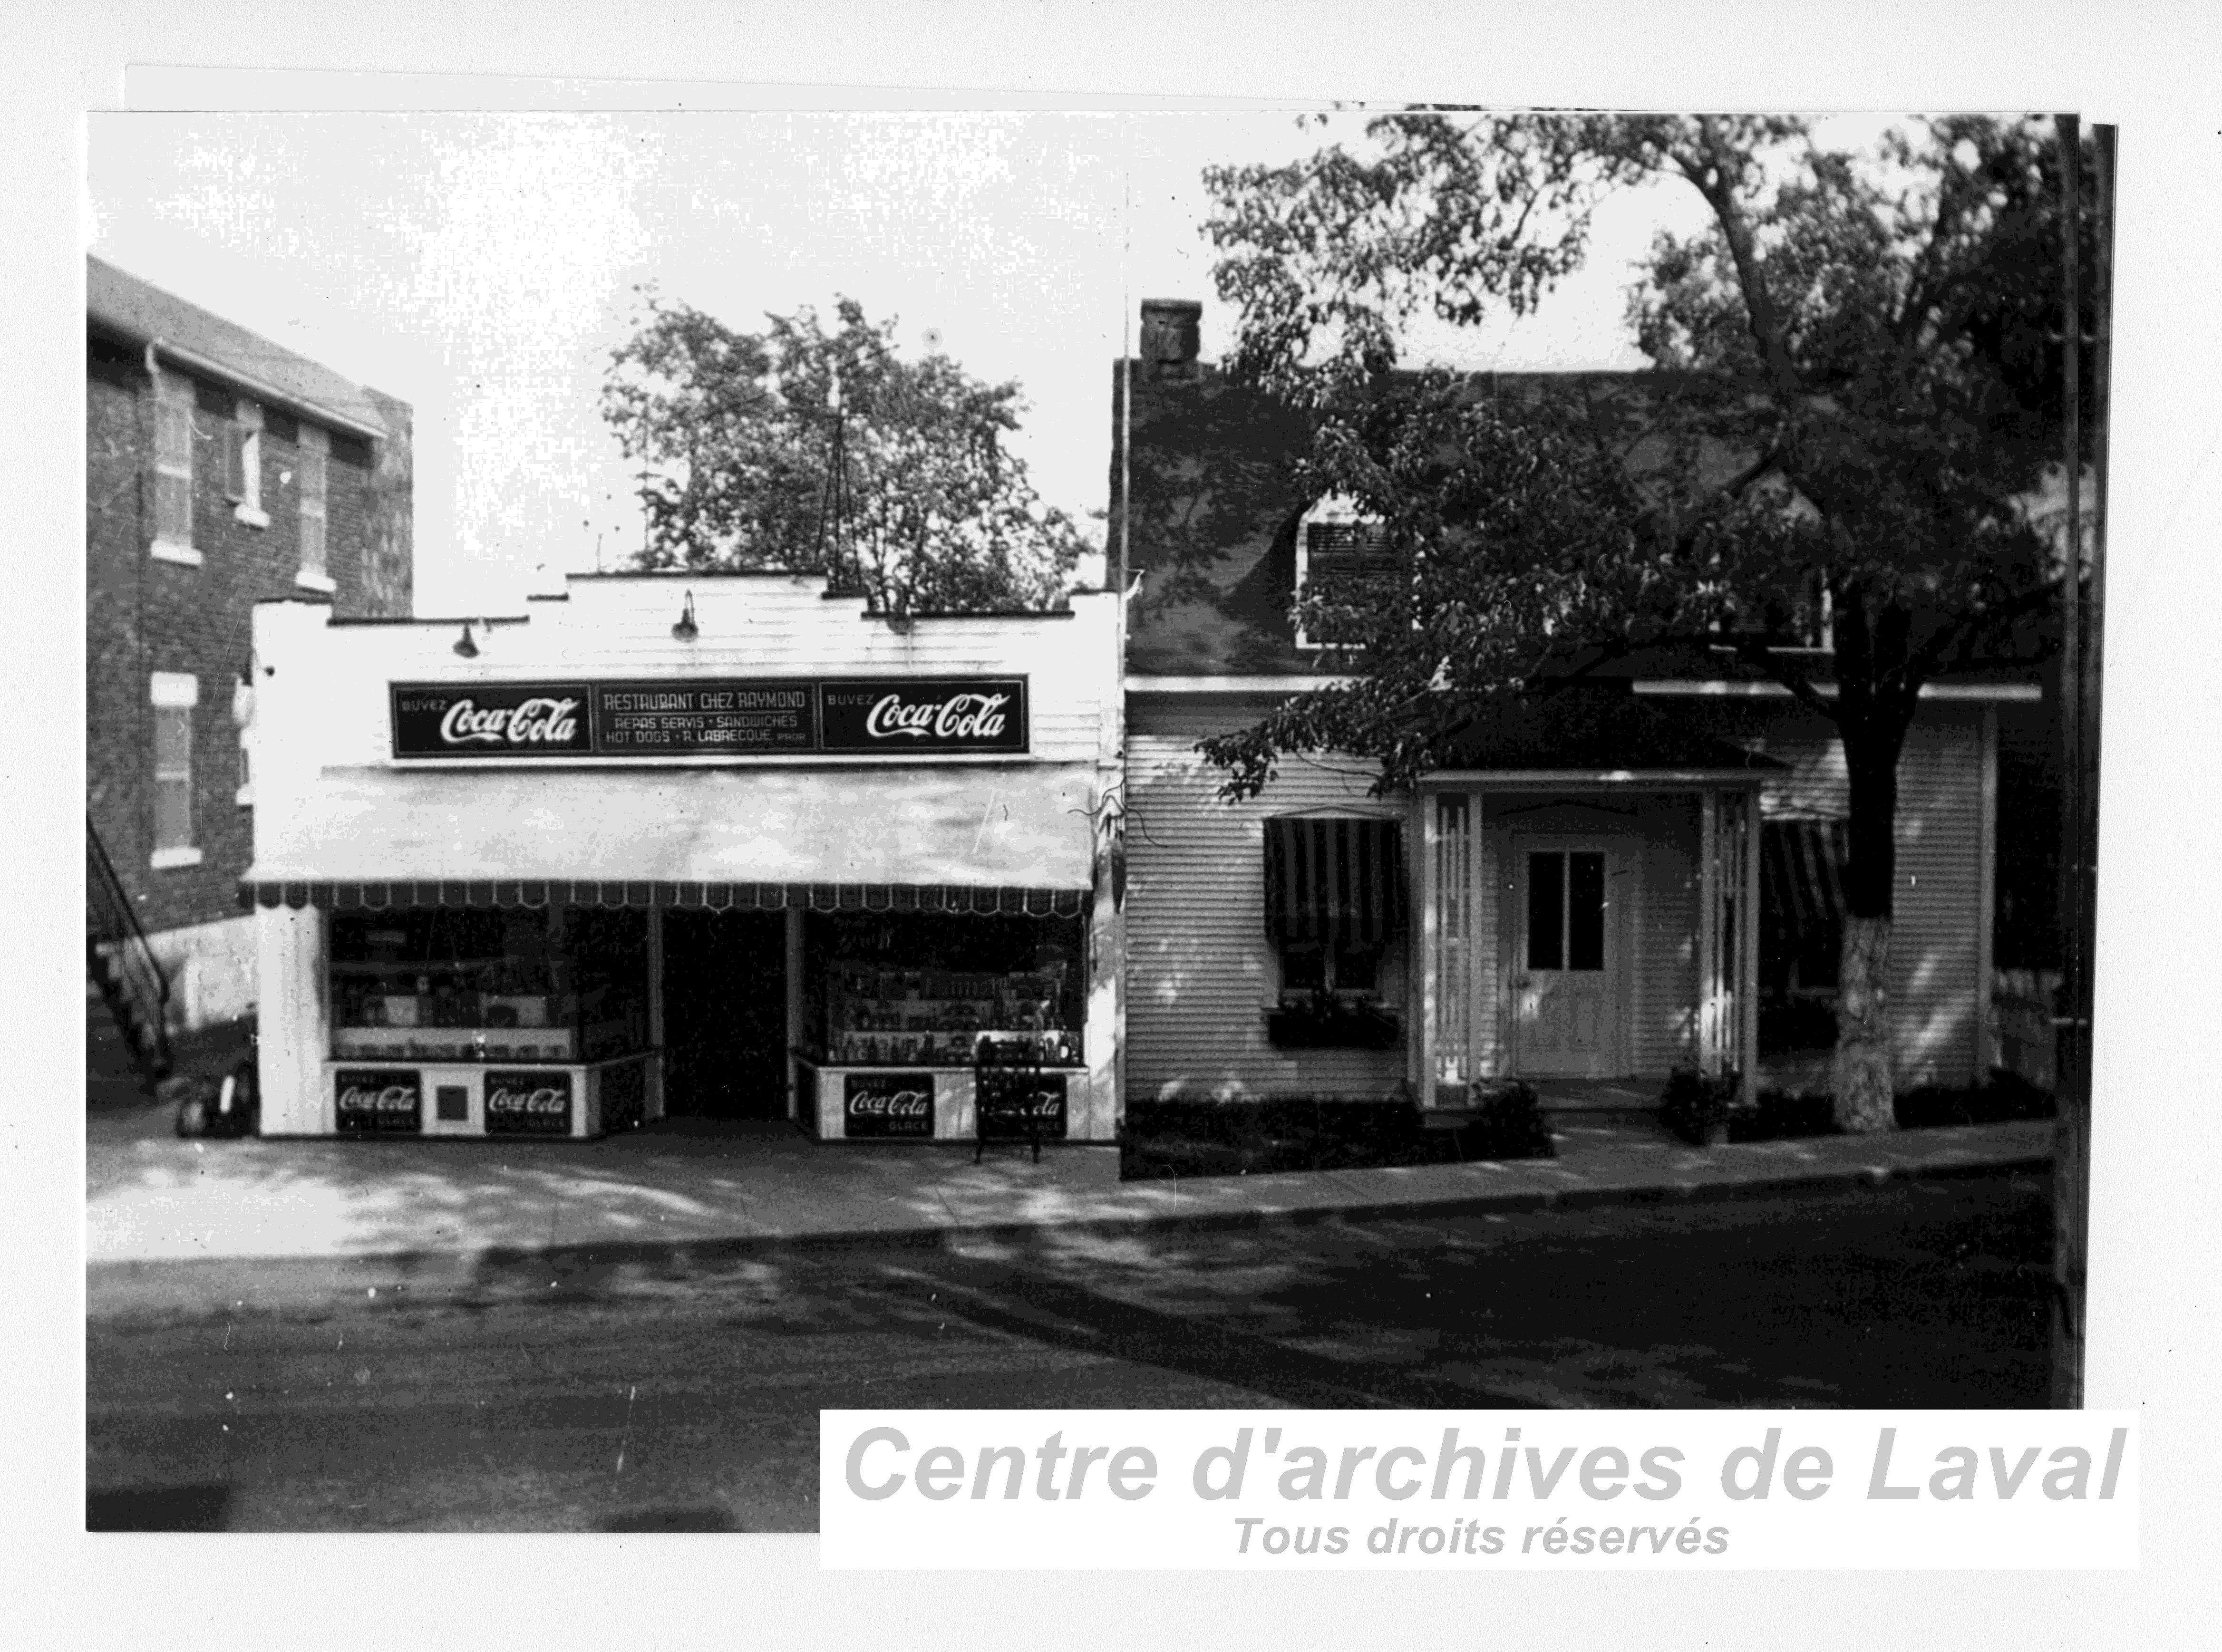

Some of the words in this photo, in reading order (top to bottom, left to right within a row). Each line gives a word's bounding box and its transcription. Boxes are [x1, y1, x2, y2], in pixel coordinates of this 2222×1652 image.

[402, 700, 446, 712] BUVEZ
[603, 693, 694, 710] RESTAURANT
[700, 692, 734, 710] CHEZ
[738, 691, 806, 709] RAYMOND
[827, 694, 874, 706] BUVEZ
[614, 717, 657, 730] REPAS
[661, 716, 704, 729] SERVIS
[716, 715, 798, 728] SANDWICHES
[606, 731, 631, 743] HOT
[635, 730, 670, 743] DOGS
